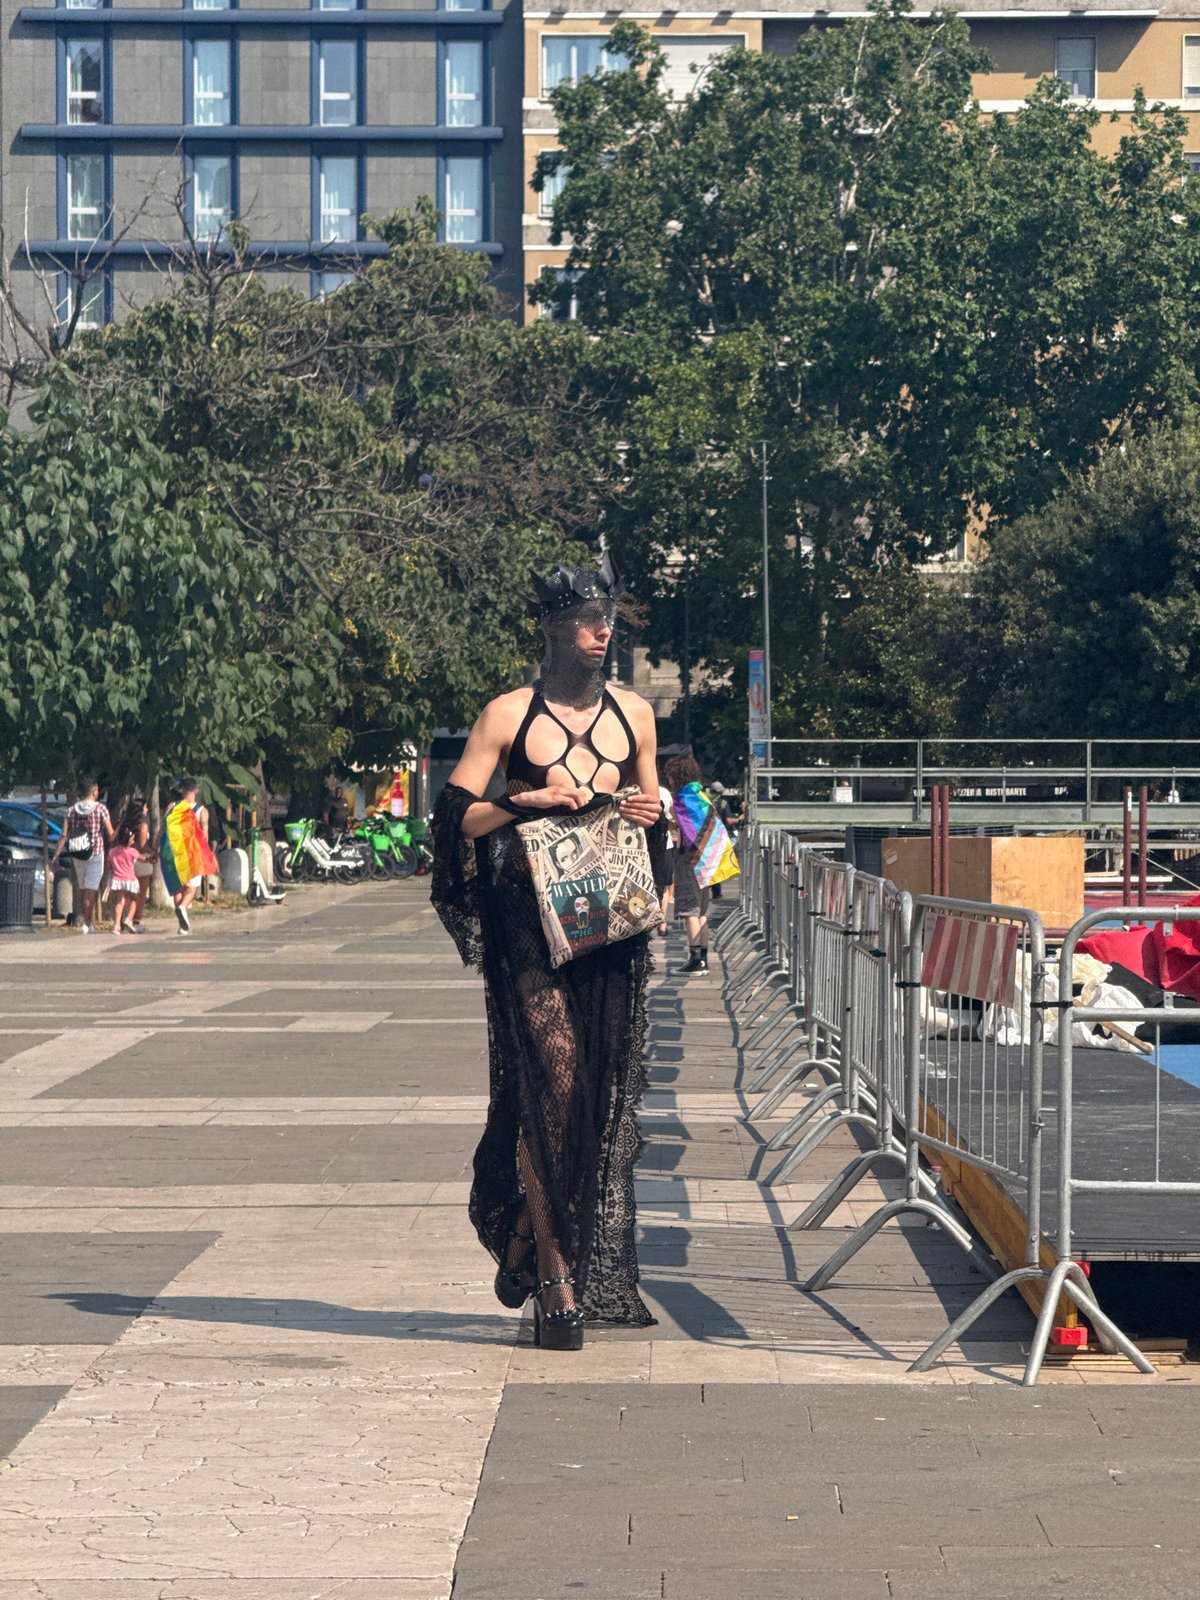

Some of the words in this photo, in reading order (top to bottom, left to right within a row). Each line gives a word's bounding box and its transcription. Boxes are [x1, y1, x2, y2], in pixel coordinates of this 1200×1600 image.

[985, 787, 1027, 796] RISTRANTE
[69, 832, 91, 852] NIKE
[553, 876, 606, 898] WANTED
